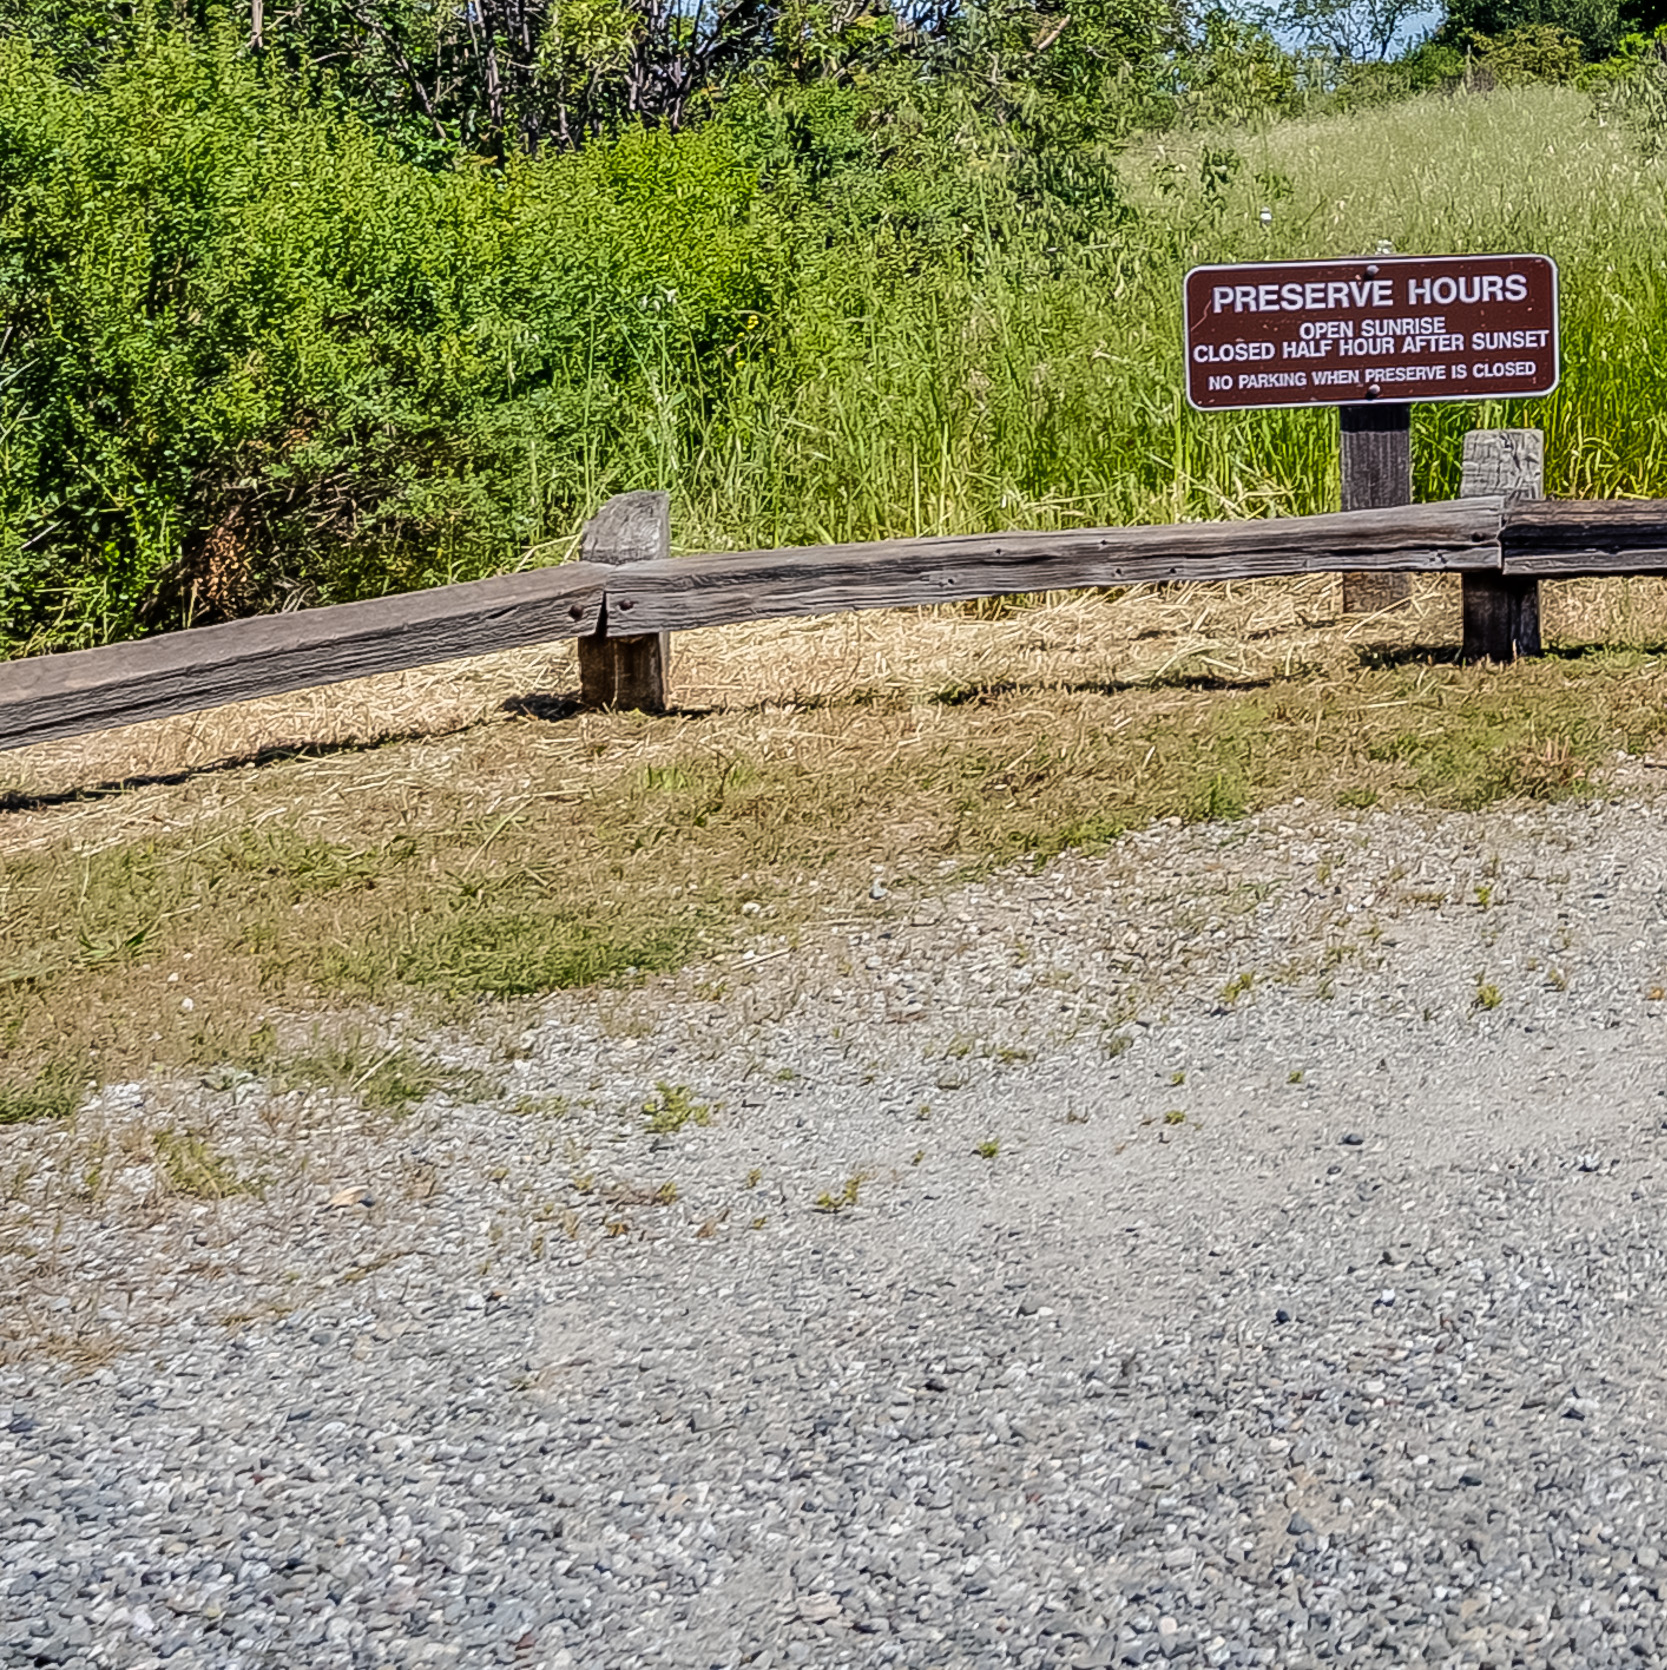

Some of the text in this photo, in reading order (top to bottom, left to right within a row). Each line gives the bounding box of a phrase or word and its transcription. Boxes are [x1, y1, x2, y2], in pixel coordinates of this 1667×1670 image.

[1212, 274, 1528, 313] PRESERVE HOURS
[1299, 316, 1446, 340] OPEN SUNRISE
[1193, 329, 1550, 363] CLOSED HALF HOUR AFTER SUNSET
[1208, 361, 1536, 391] NO PARKING WHEN PRESERVE IS CLOSED
